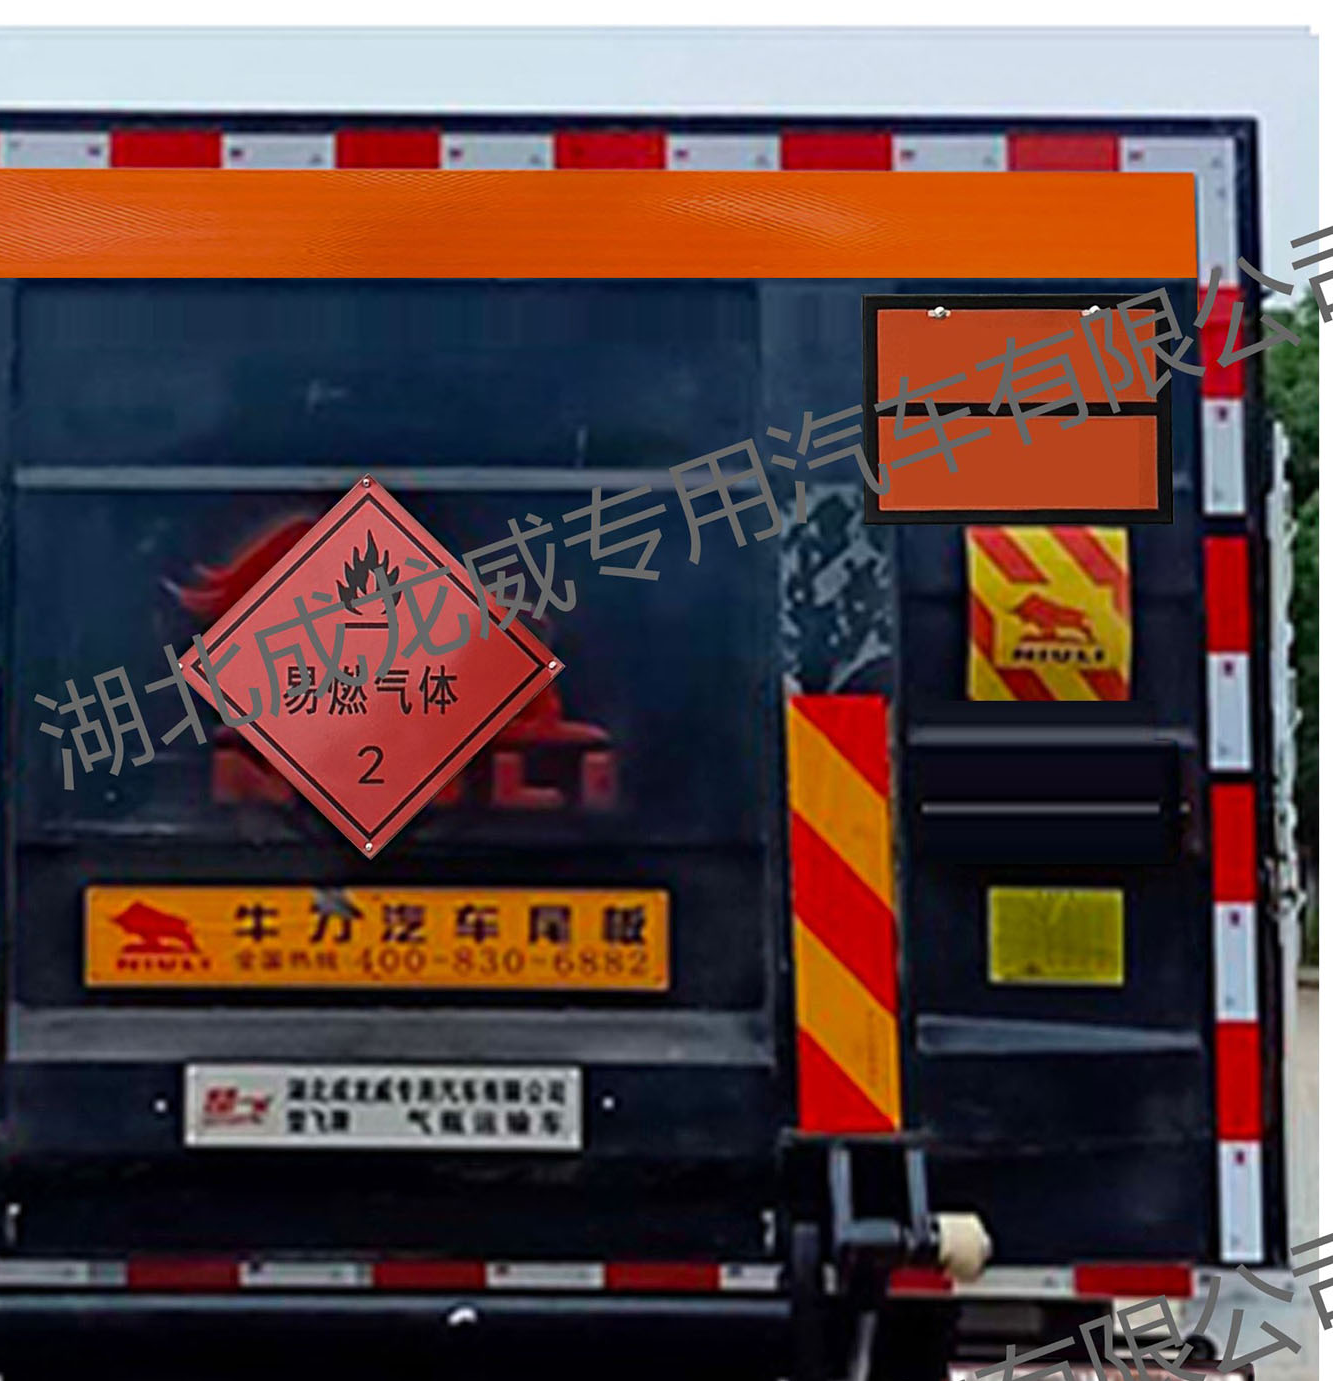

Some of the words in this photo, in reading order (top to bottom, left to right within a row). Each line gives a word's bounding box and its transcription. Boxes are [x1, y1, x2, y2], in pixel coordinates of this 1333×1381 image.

[282, 664, 459, 716] 易燃气体
[357, 744, 385, 785] 2
[354, 949, 650, 977] 400-830-6882
